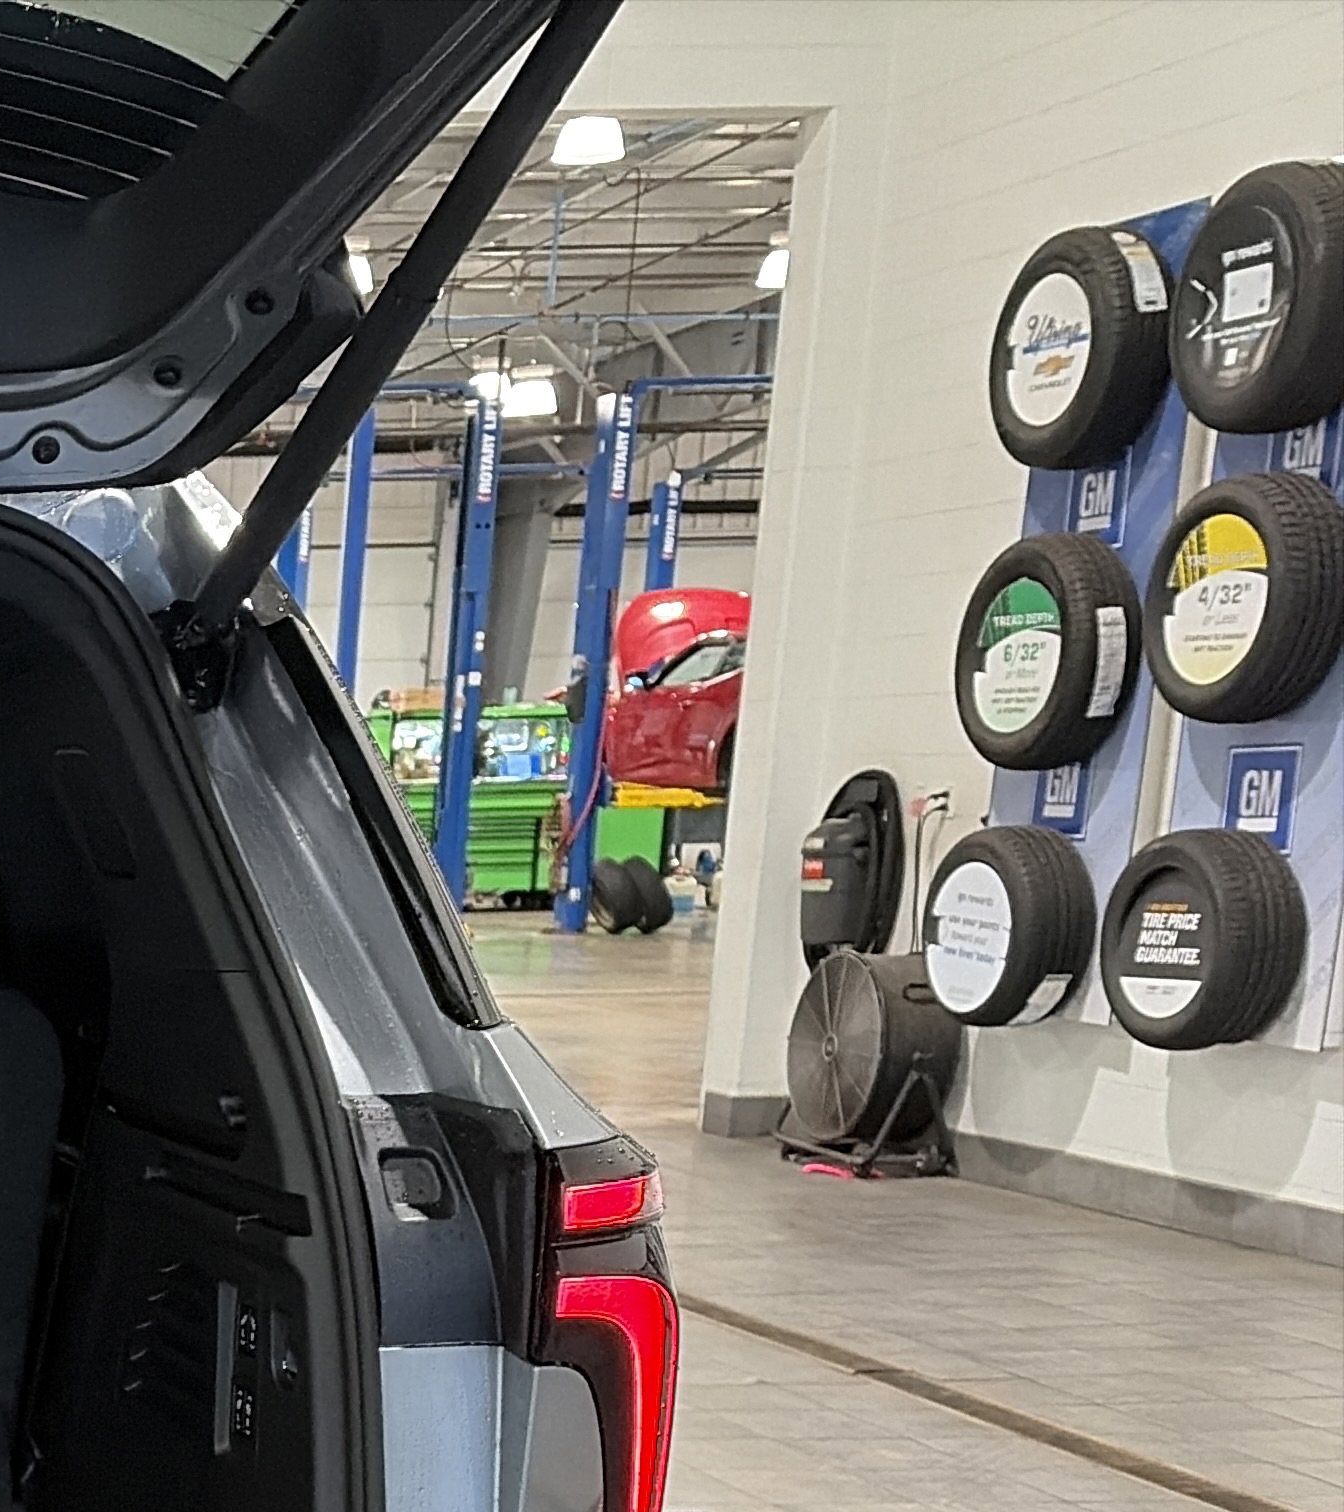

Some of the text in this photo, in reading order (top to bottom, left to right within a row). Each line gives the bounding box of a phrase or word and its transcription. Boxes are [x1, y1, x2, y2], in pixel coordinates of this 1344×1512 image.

[478, 433, 496, 493] ROTARY
[612, 394, 634, 492] ROTARY LIFT
[1284, 423, 1326, 468] GM
[1079, 469, 1117, 518] GM
[1198, 583, 1252, 611] 4/32"
[993, 614, 1025, 627] TREAD
[1004, 642, 1048, 667] 6/32"
[1046, 762, 1081, 804] GM
[1240, 769, 1283, 817] GM
[1138, 930, 1179, 946] MATCH
[1142, 912, 1202, 931] TIRE PRICE
